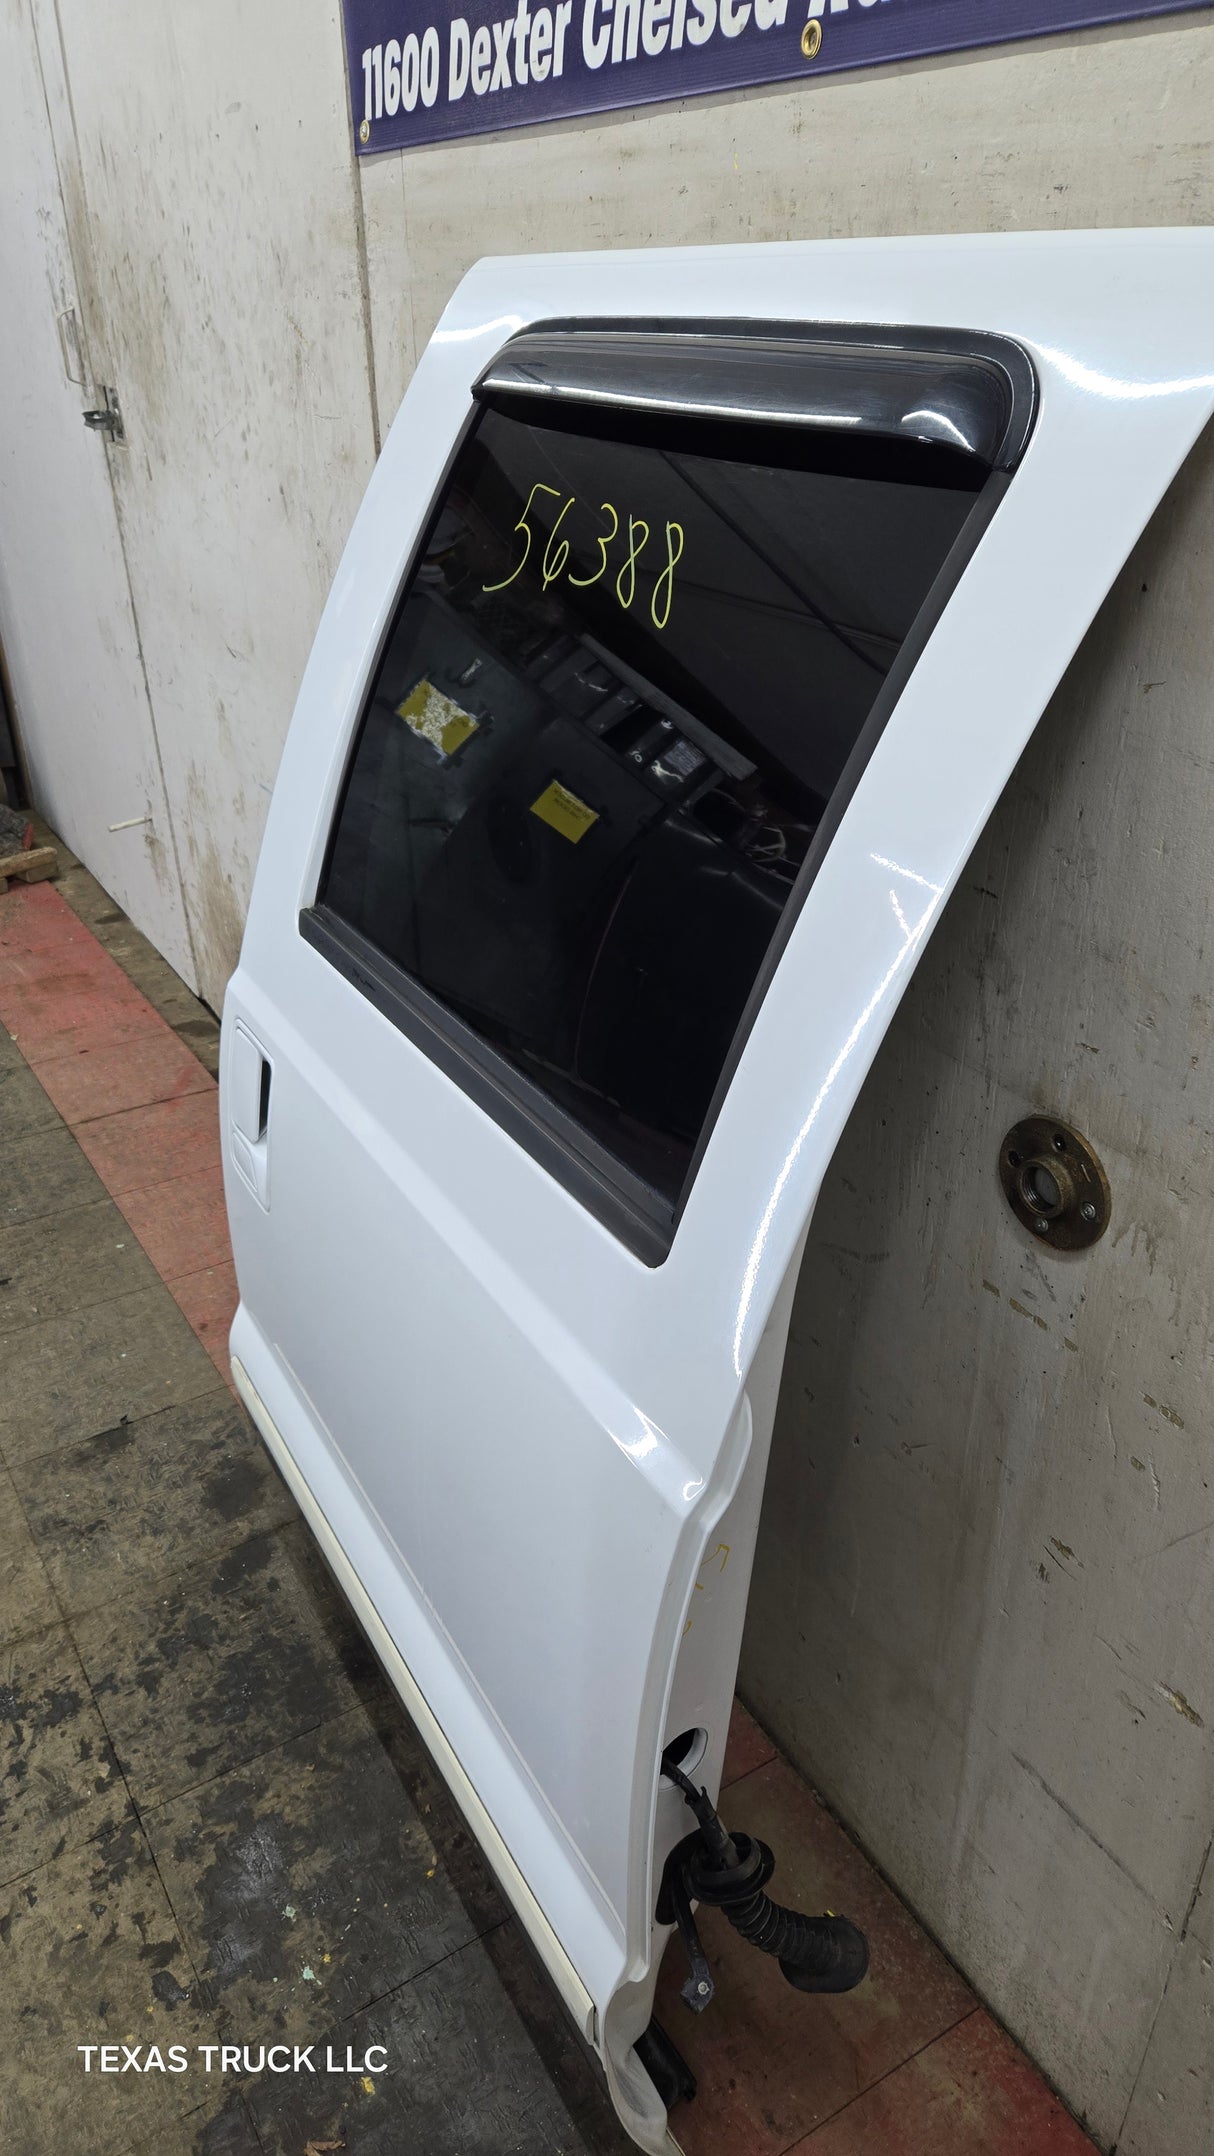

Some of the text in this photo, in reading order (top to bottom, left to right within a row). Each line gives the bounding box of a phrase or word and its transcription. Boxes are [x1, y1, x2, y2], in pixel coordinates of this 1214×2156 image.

[362, 27, 440, 120] 11600
[448, 0, 573, 101] Dexter
[482, 483, 684, 629] 56388
